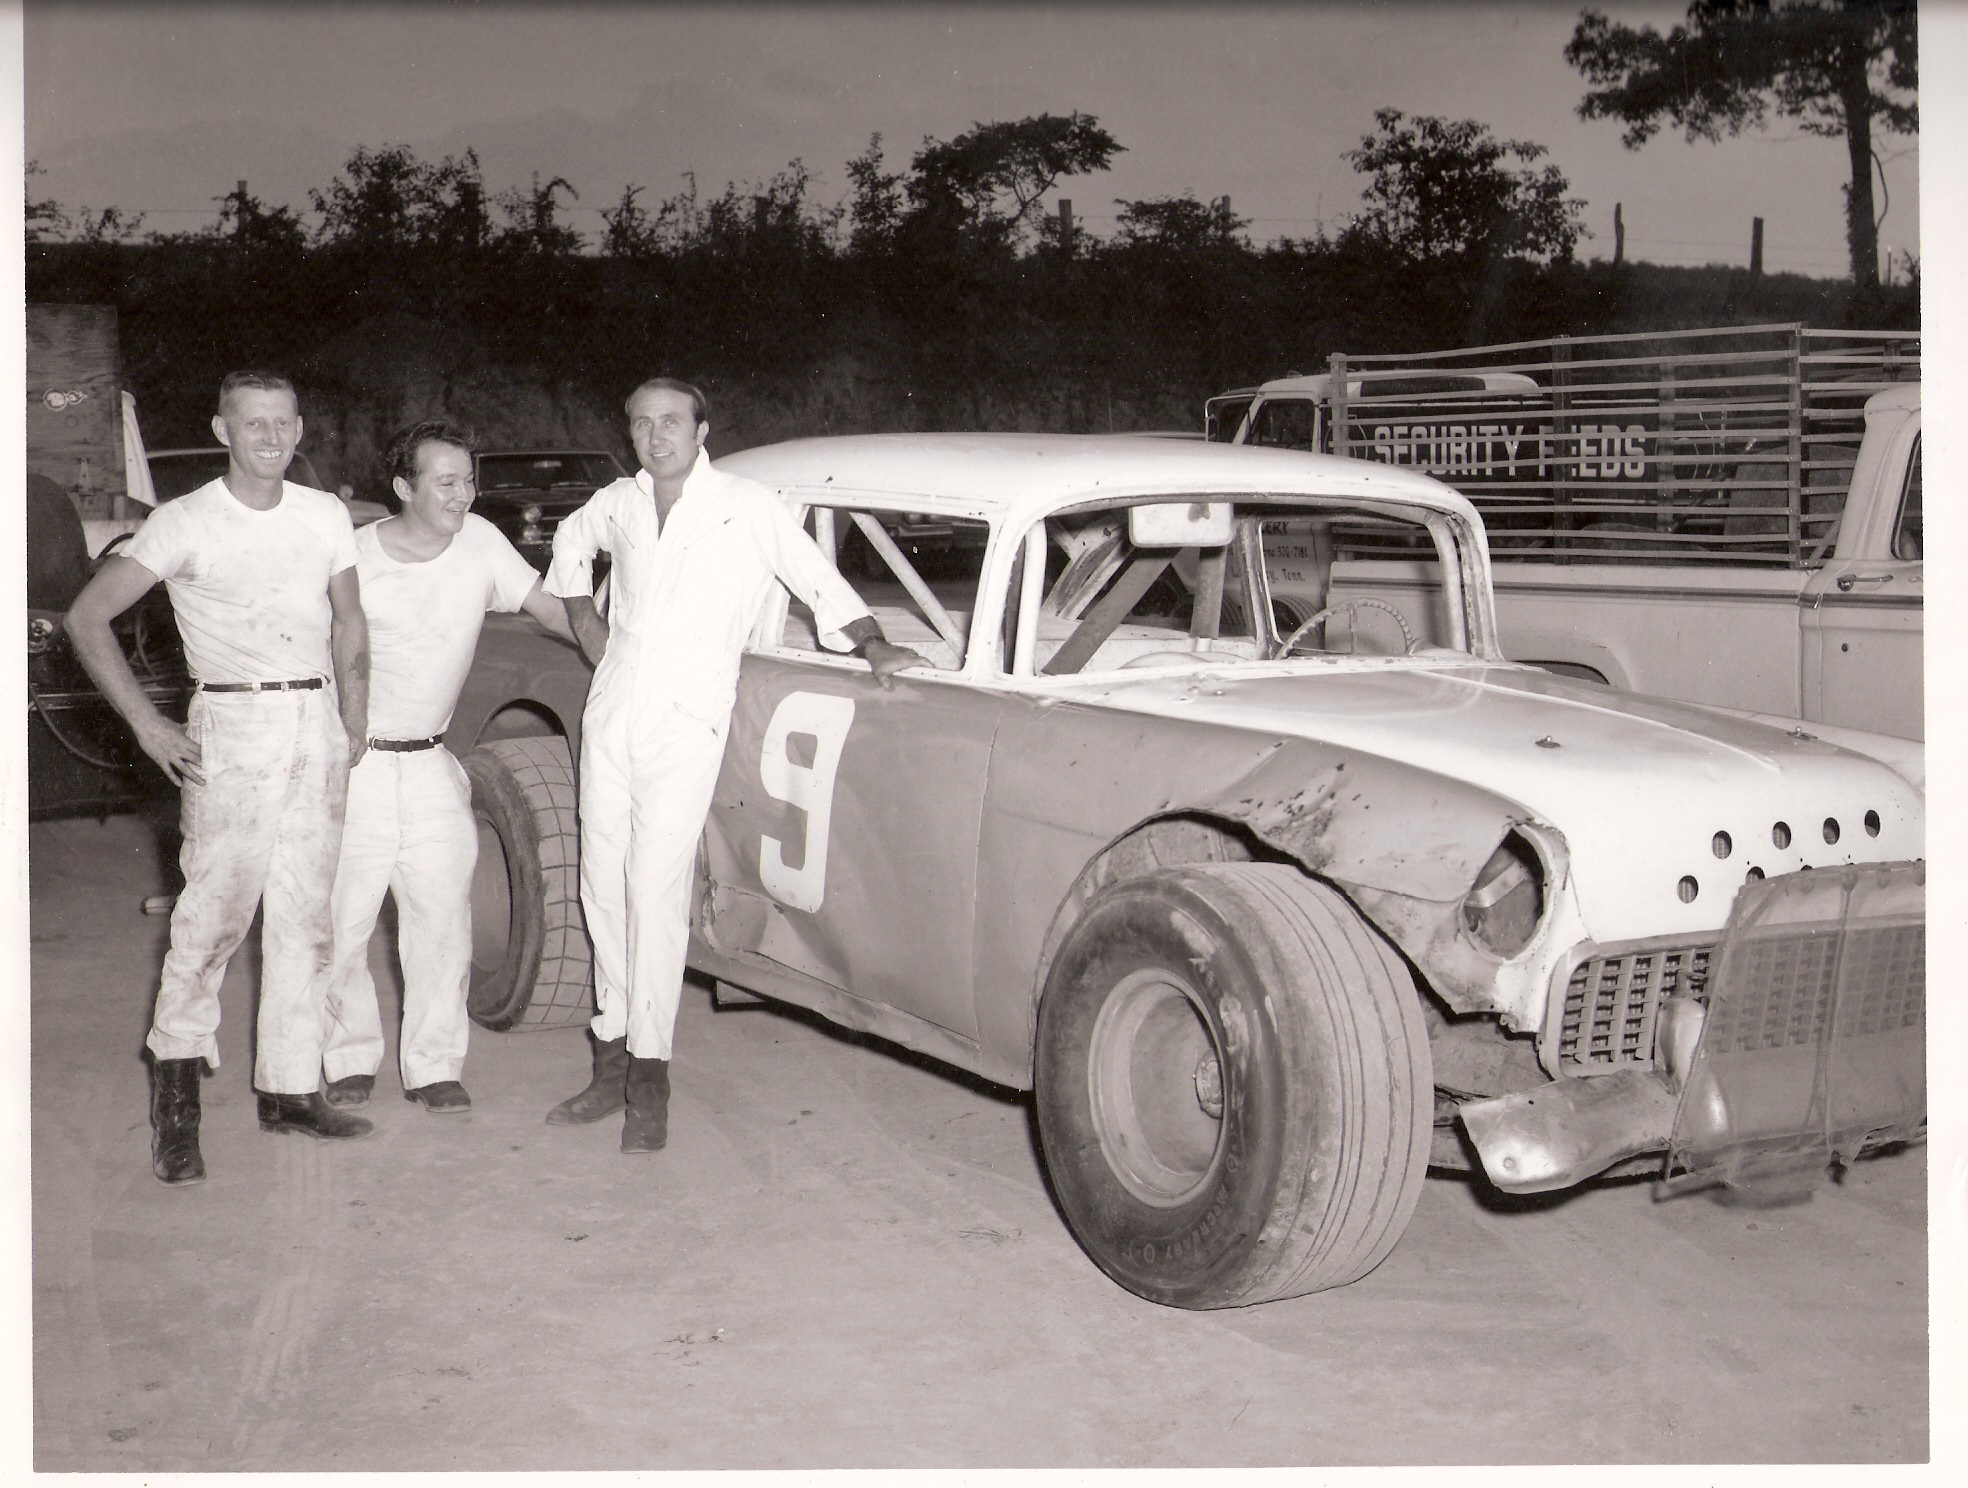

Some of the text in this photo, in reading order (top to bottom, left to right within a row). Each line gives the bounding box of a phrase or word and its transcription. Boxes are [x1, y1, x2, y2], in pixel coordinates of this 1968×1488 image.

[1374, 425, 1646, 478] SECURITY FEDS
[1262, 521, 1289, 535] ERY
[1281, 568, 1306, 581] Tenn.
[759, 690, 855, 914] 9
